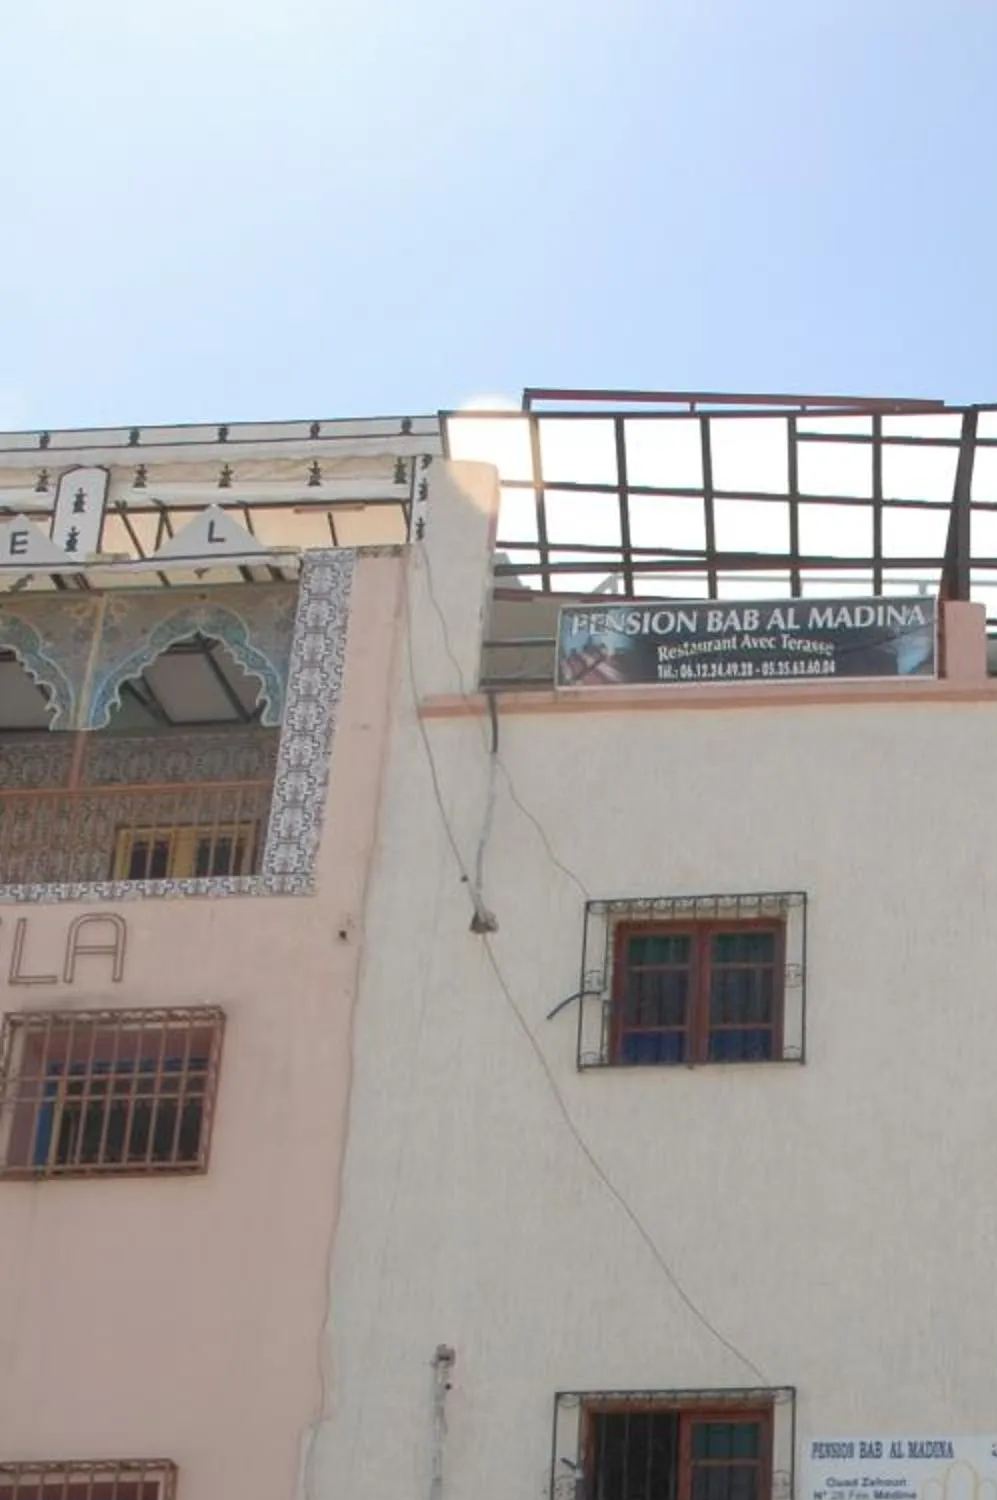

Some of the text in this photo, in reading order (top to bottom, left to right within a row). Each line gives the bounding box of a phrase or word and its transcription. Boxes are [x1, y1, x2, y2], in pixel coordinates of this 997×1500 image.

[571, 603, 926, 637] PENSION BAB AL MADINA
[657, 633, 836, 662] Restaurant Avec Terasse
[0, 912, 127, 985] LA
[859, 1441, 883, 1459] BAB
[890, 1440, 905, 1458] AL
[908, 1440, 954, 1458] MADINA
